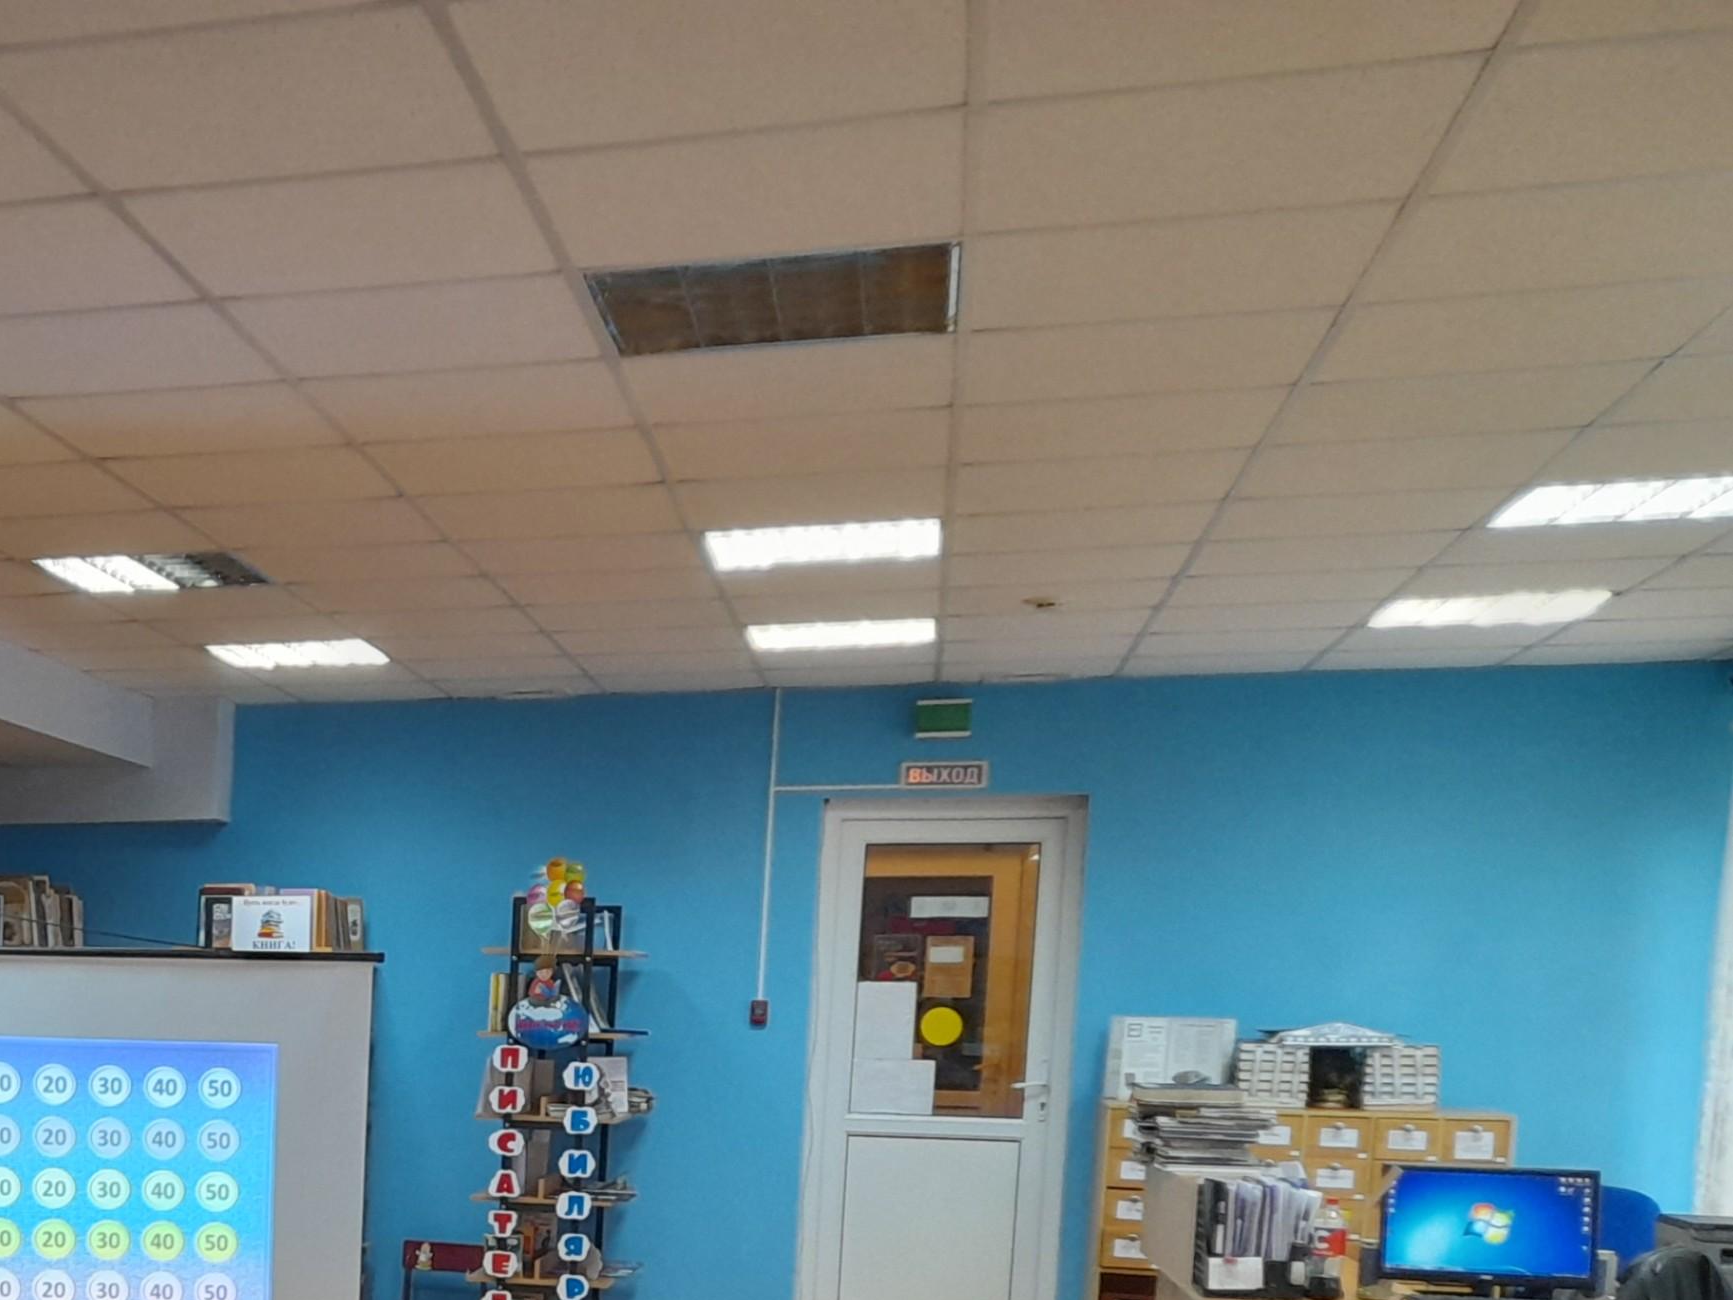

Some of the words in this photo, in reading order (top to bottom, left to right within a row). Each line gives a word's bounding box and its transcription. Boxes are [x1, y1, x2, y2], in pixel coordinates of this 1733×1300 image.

[909, 767, 979, 784] ВЫХОД
[252, 940, 295, 950] КНИГА!
[43, 1075, 67, 1093] 20
[98, 1077, 122, 1095] 30
[152, 1078, 177, 1096] 40
[208, 1080, 232, 1097] 50
[43, 1128, 67, 1145] 20
[97, 1130, 122, 1147] 30
[152, 1131, 176, 1148] 40
[207, 1132, 231, 1149] 50
[42, 1180, 66, 1197] 20
[97, 1181, 121, 1198] 30
[151, 1183, 175, 1199] 40
[206, 1184, 229, 1200] 50
[42, 1231, 66, 1248] 20
[97, 1232, 121, 1249] 30
[150, 1233, 174, 1250] 40
[205, 1234, 228, 1251] 50
[42, 1282, 66, 1298] 20
[96, 1283, 120, 1299] 30
[150, 1284, 174, 1300] 40
[204, 1285, 227, 1300] 50
